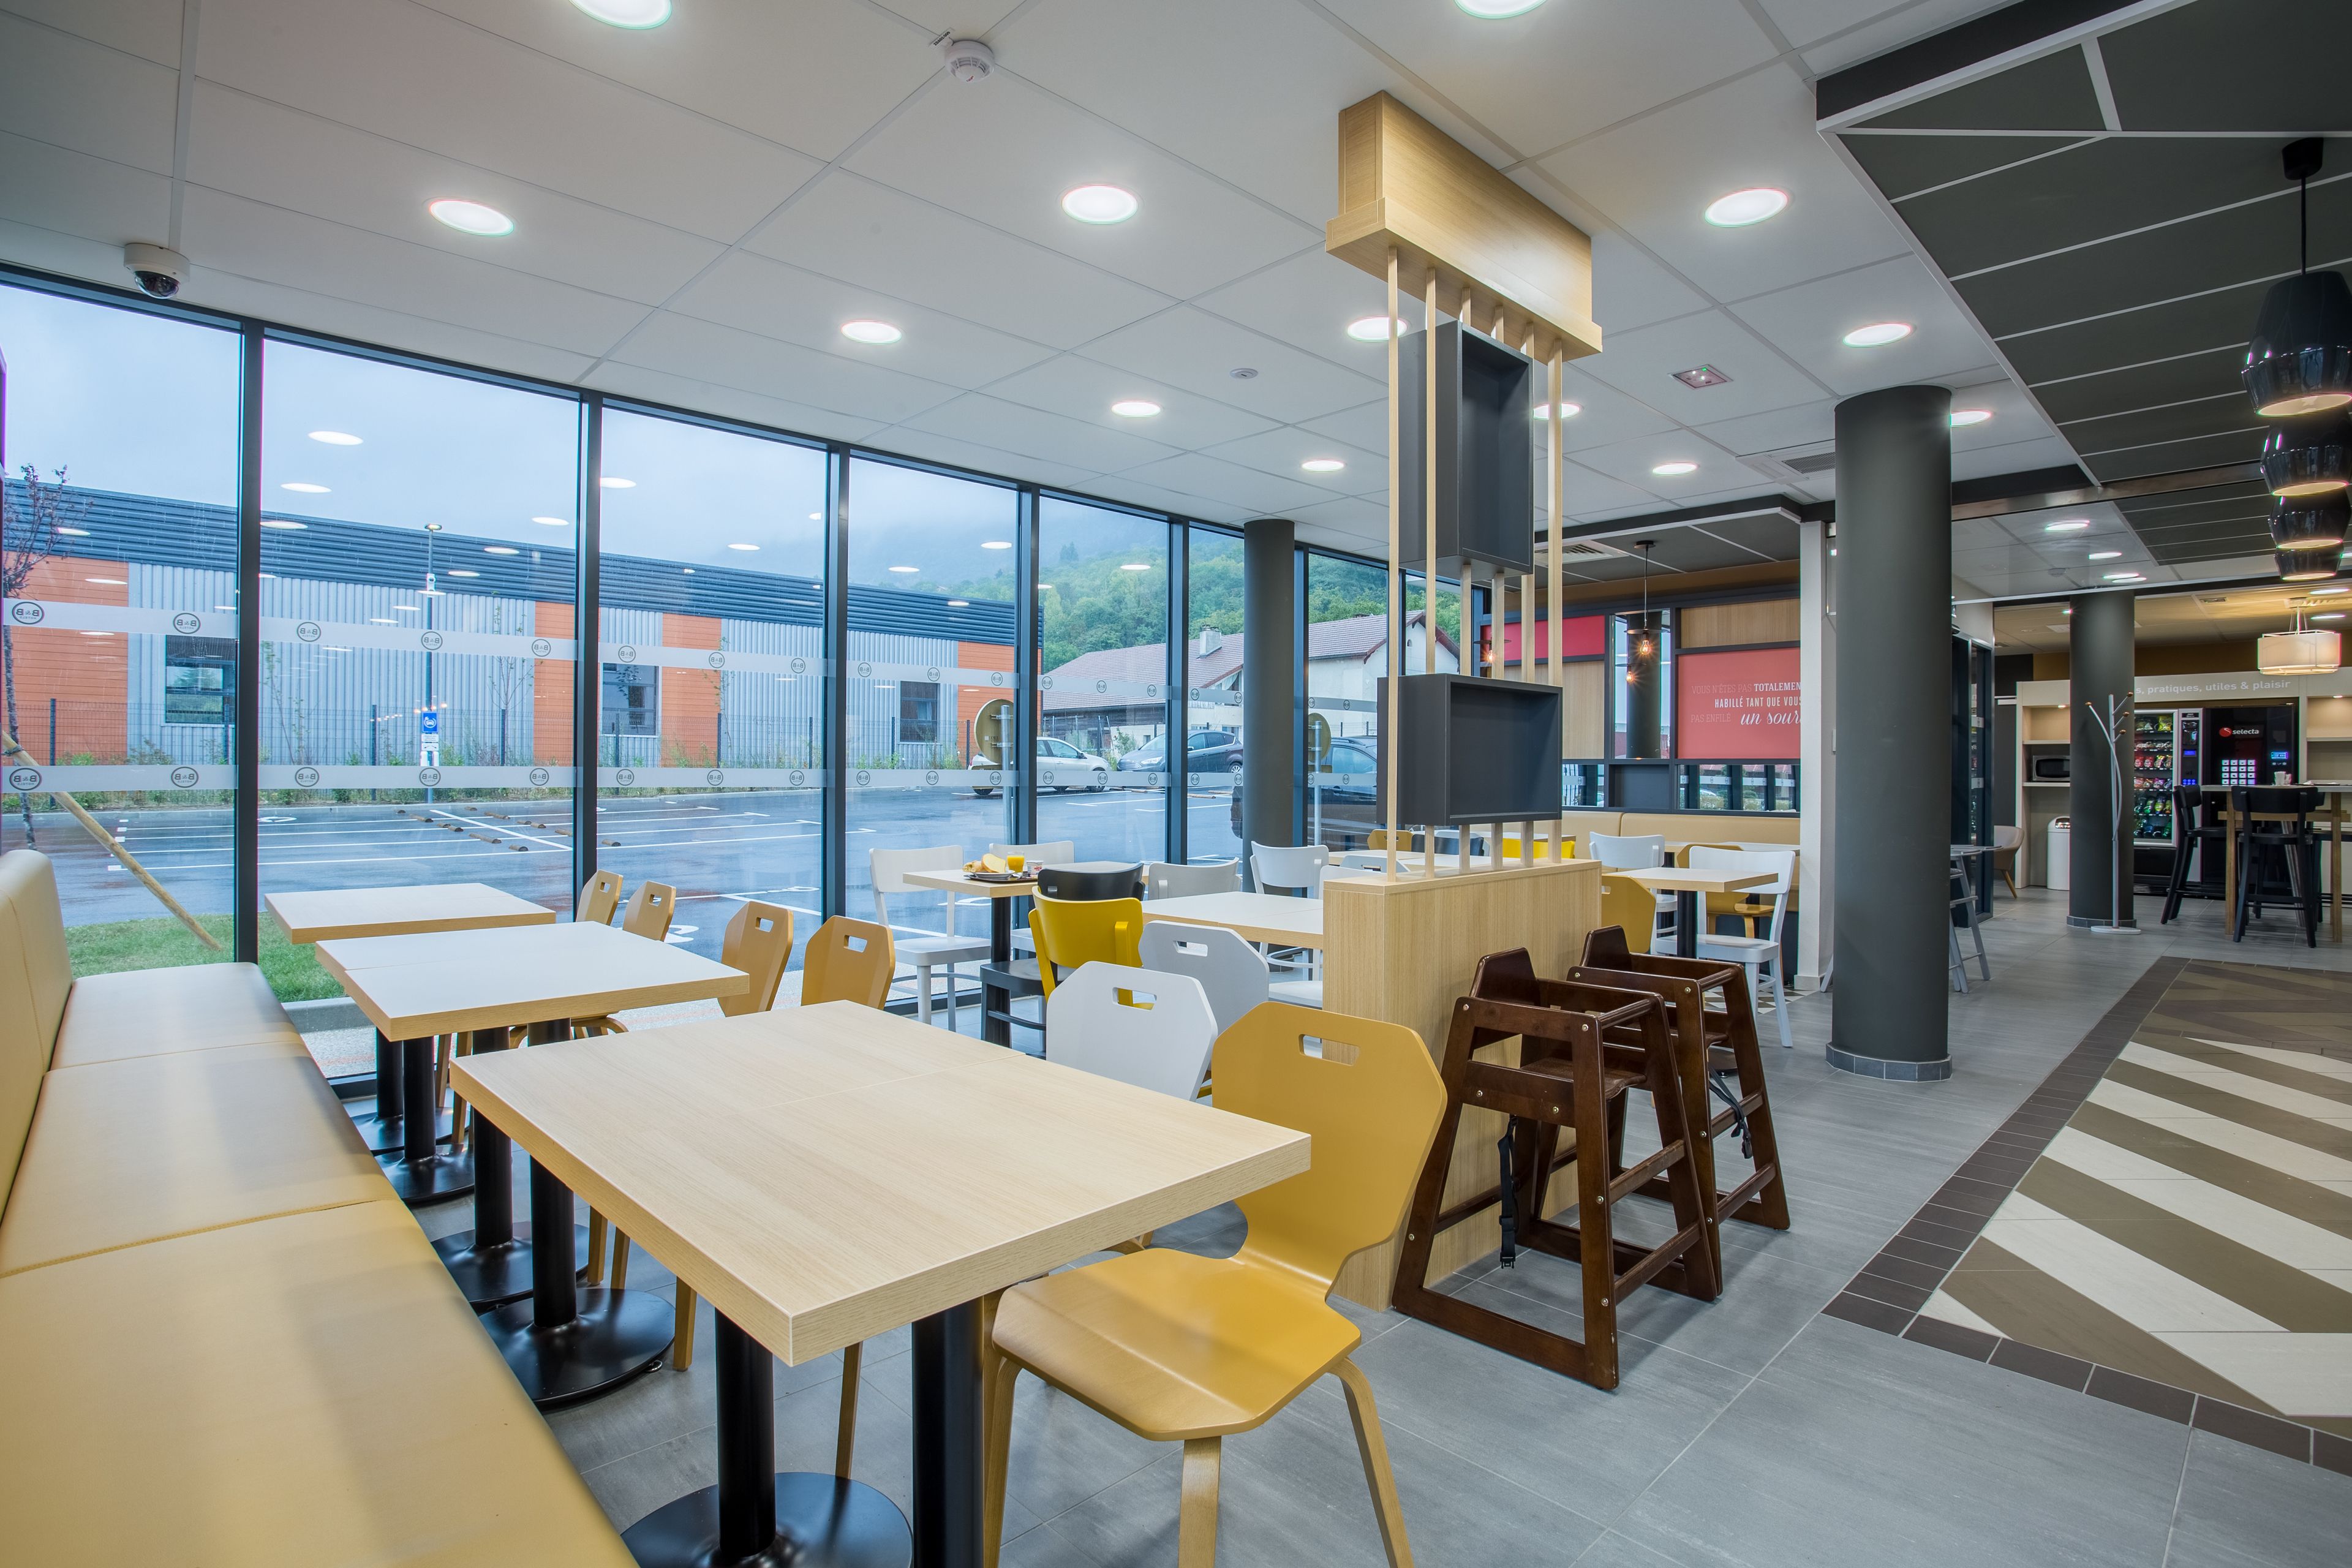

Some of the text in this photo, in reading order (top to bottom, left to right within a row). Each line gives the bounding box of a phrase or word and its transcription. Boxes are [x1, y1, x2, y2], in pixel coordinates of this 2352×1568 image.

[1691, 685, 1711, 694] VOUS
[1738, 684, 1752, 692] PAS
[2147, 685, 2202, 695] pratiques,
[2241, 681, 2248, 690] &
[2253, 680, 2291, 690] plaisir
[1715, 696, 1743, 708] HABILLÉ
[1746, 698, 1763, 707] TANT
[1766, 696, 1781, 707] QUE
[1691, 710, 1801, 725] PAS ENFILÉ un sour
